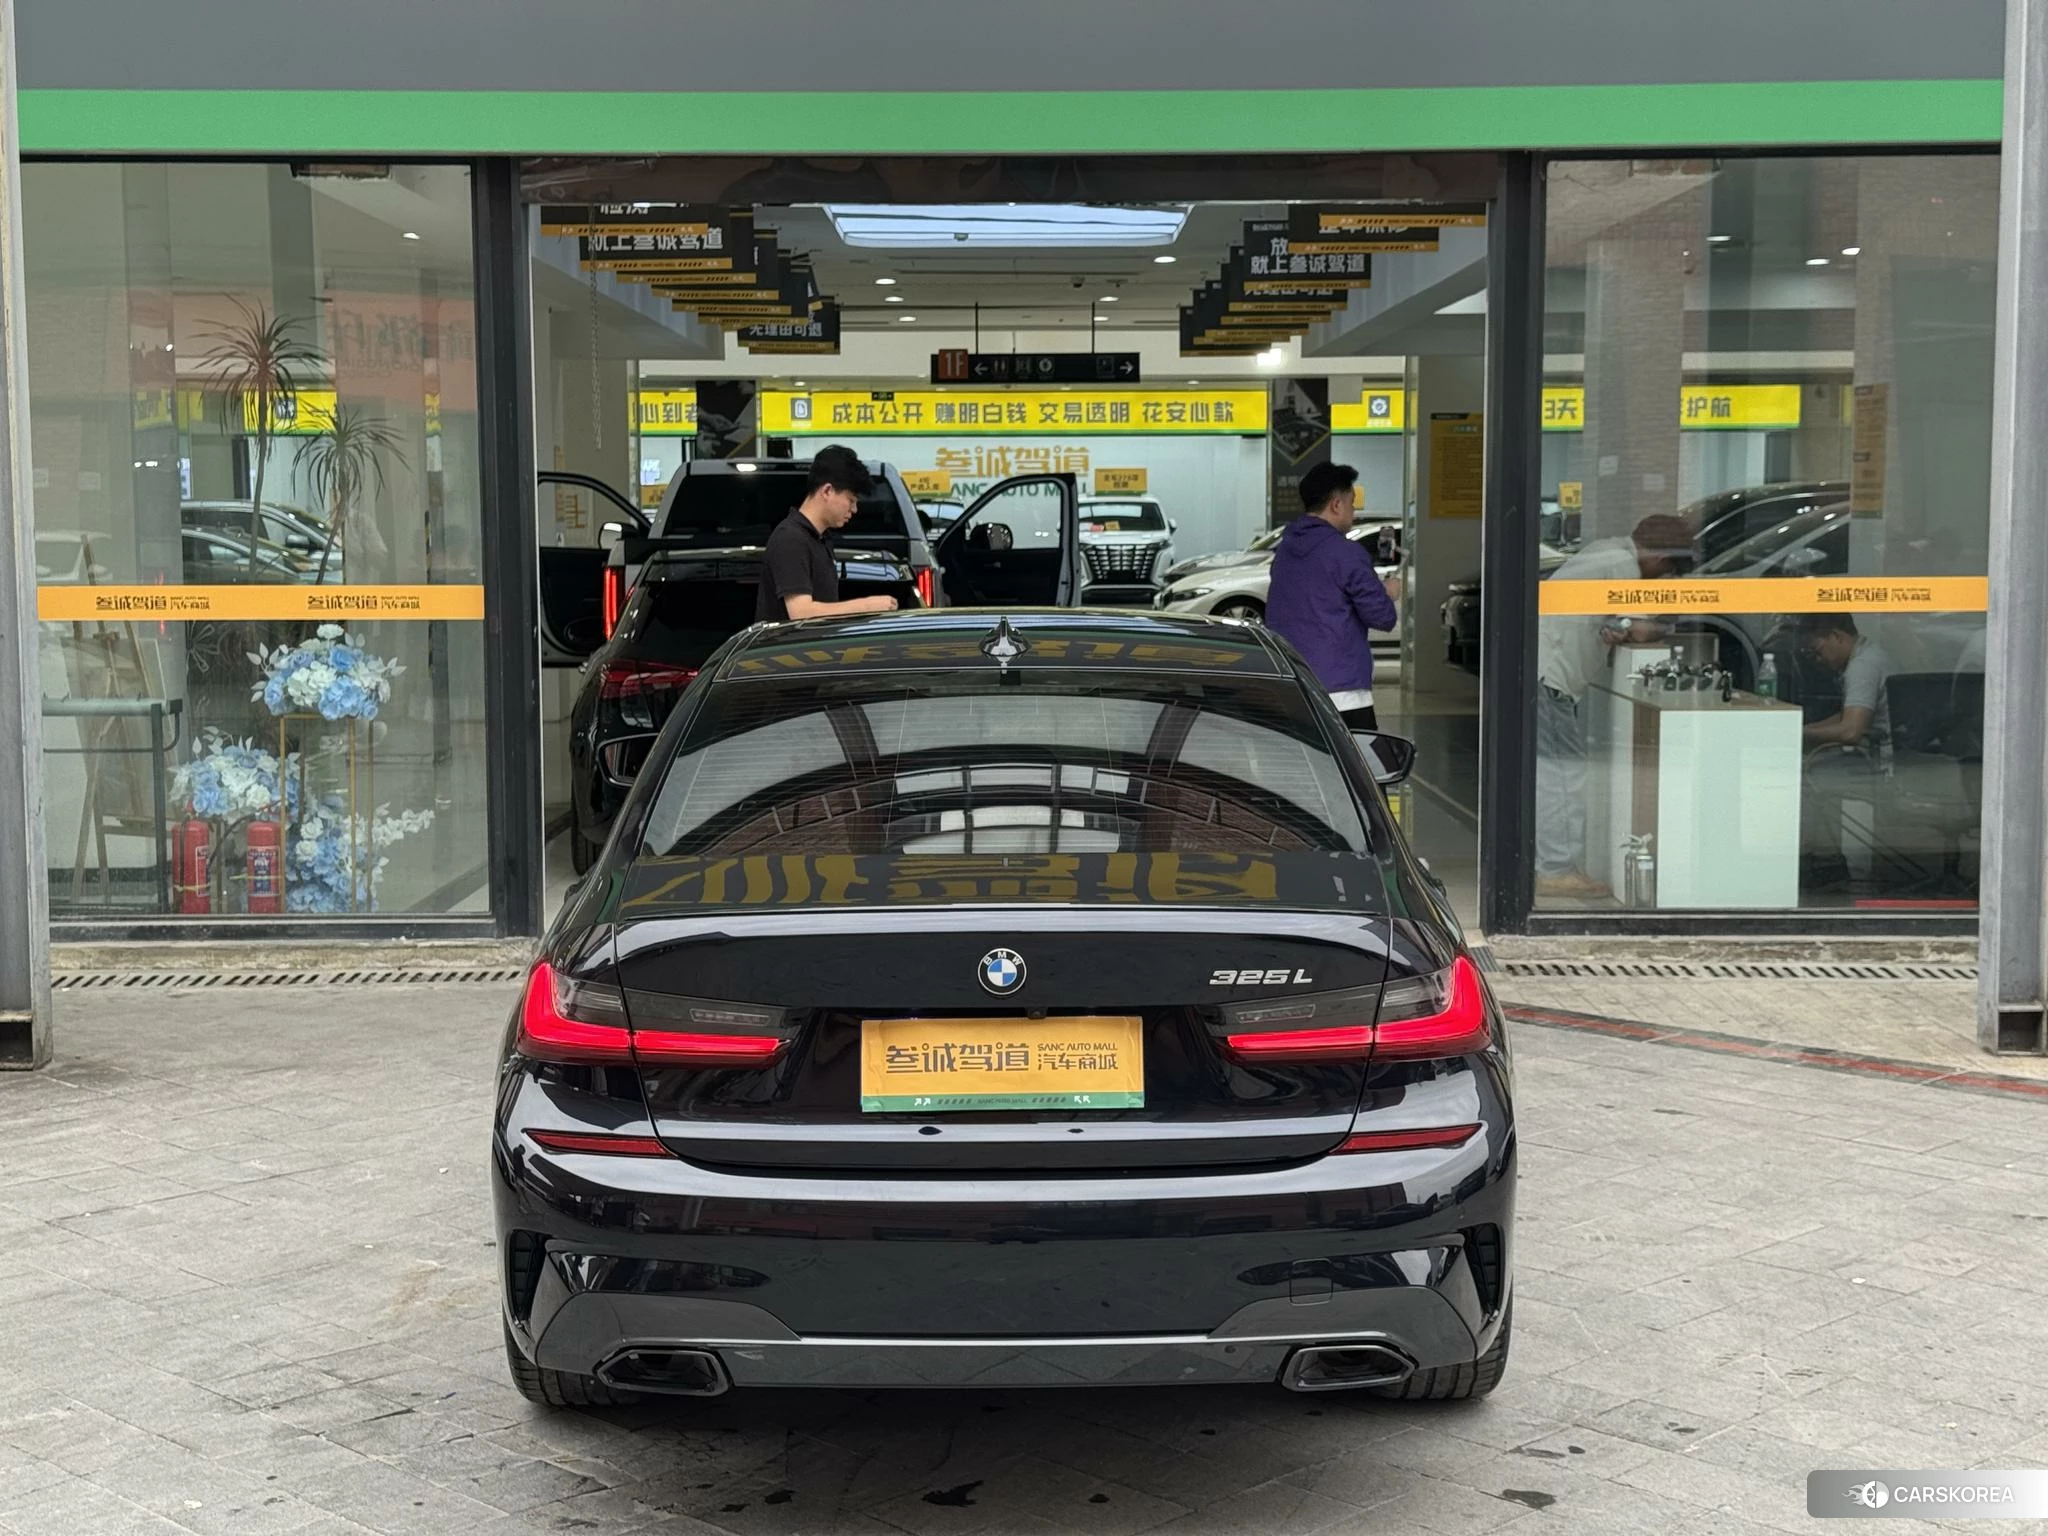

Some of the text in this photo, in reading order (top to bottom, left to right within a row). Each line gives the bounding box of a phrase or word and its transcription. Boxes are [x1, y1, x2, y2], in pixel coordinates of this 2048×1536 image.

[832, 401, 1234, 424] 成本公开 赚明白钱 交易透明 花安心款
[950, 482, 988, 497] ANC
[1001, 482, 1039, 497] UTO
[1037, 1042, 1118, 1051] SANC AUTO MALL
[885, 1042, 1030, 1074] 叁诚驾道
[1038, 1053, 1119, 1070] 汽车商城
